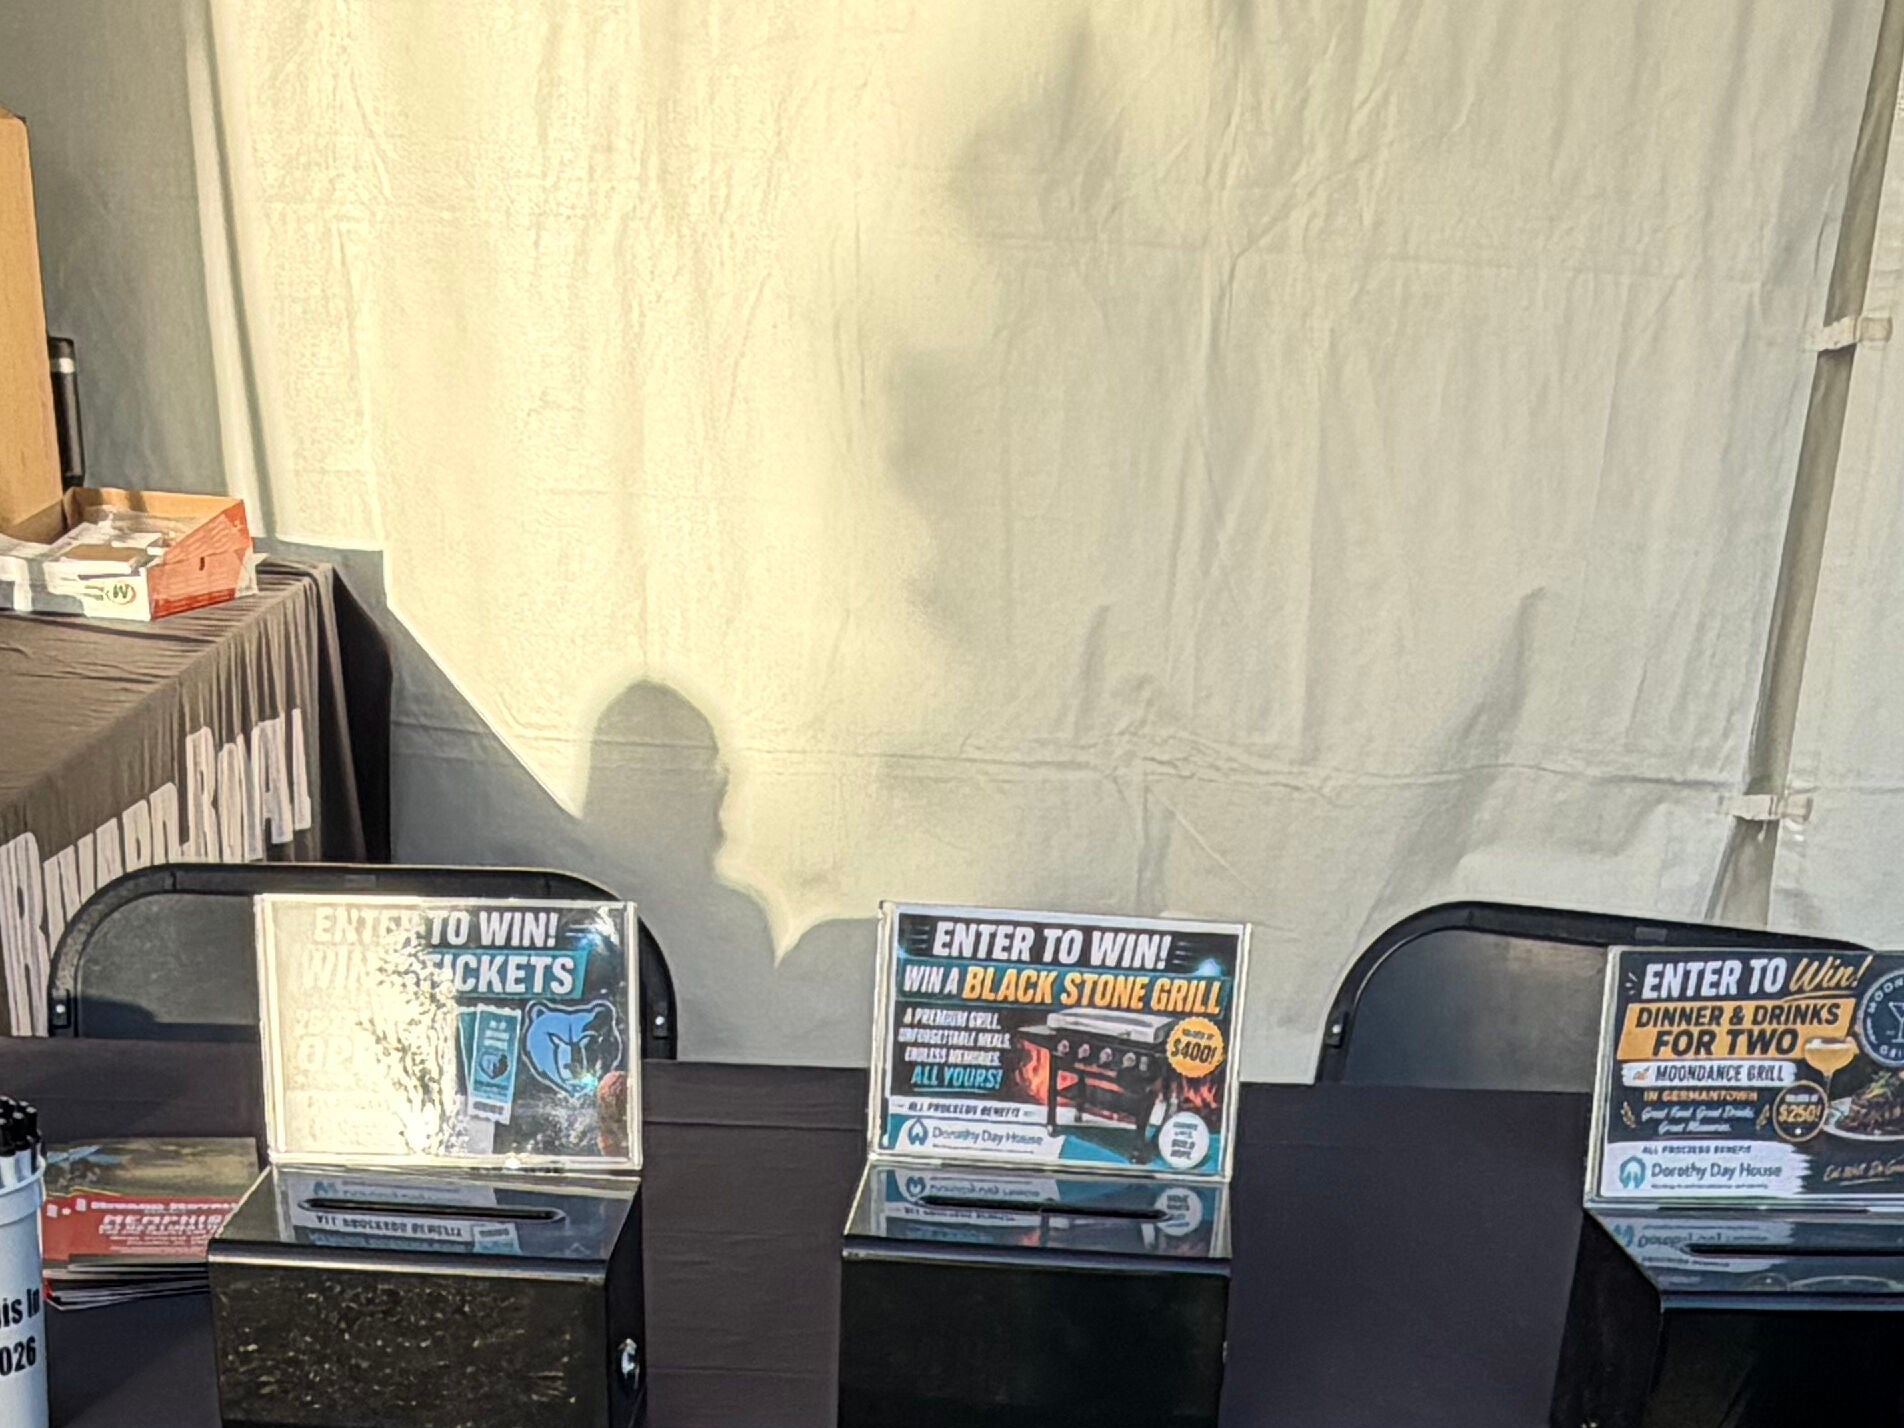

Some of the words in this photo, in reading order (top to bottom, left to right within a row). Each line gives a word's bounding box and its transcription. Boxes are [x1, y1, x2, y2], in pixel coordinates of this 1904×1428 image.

[428, 909, 470, 945] TO
[479, 910, 560, 948] WIN!
[932, 921, 1036, 962] ENTER
[1043, 929, 1083, 965] TO
[1091, 931, 1173, 970] WIN!
[903, 965, 944, 994] WIN
[944, 967, 960, 994] A
[962, 966, 1059, 1005] BLACK
[1060, 973, 1149, 1010] STONE
[1150, 978, 1222, 1015] GRILL
[1641, 960, 1743, 1000] ENTER
[1749, 957, 1788, 994] TO
[1789, 955, 1874, 992] Win!
[1635, 1005, 1724, 1028] DINNER
[1729, 1005, 1746, 1026] &
[1751, 1002, 1841, 1026] DRINKS
[1171, 1038, 1216, 1064] $400!
[1652, 1029, 1717, 1056] FOR
[1726, 1028, 1799, 1055] TWO
[911, 1065, 938, 1085] ALL
[943, 1066, 1004, 1089] YOURS!
[1655, 1065, 1741, 1082] MOONDANCE
[1747, 1065, 1784, 1082] GRILL
[1643, 1090, 1658, 1101] IN
[1778, 1103, 1821, 1123] $250!
[982, 1129, 1004, 1145] Day
[1651, 1162, 1707, 1181] Dorothy
[1710, 1163, 1737, 1181] Day
[1739, 1162, 1783, 1178] House
